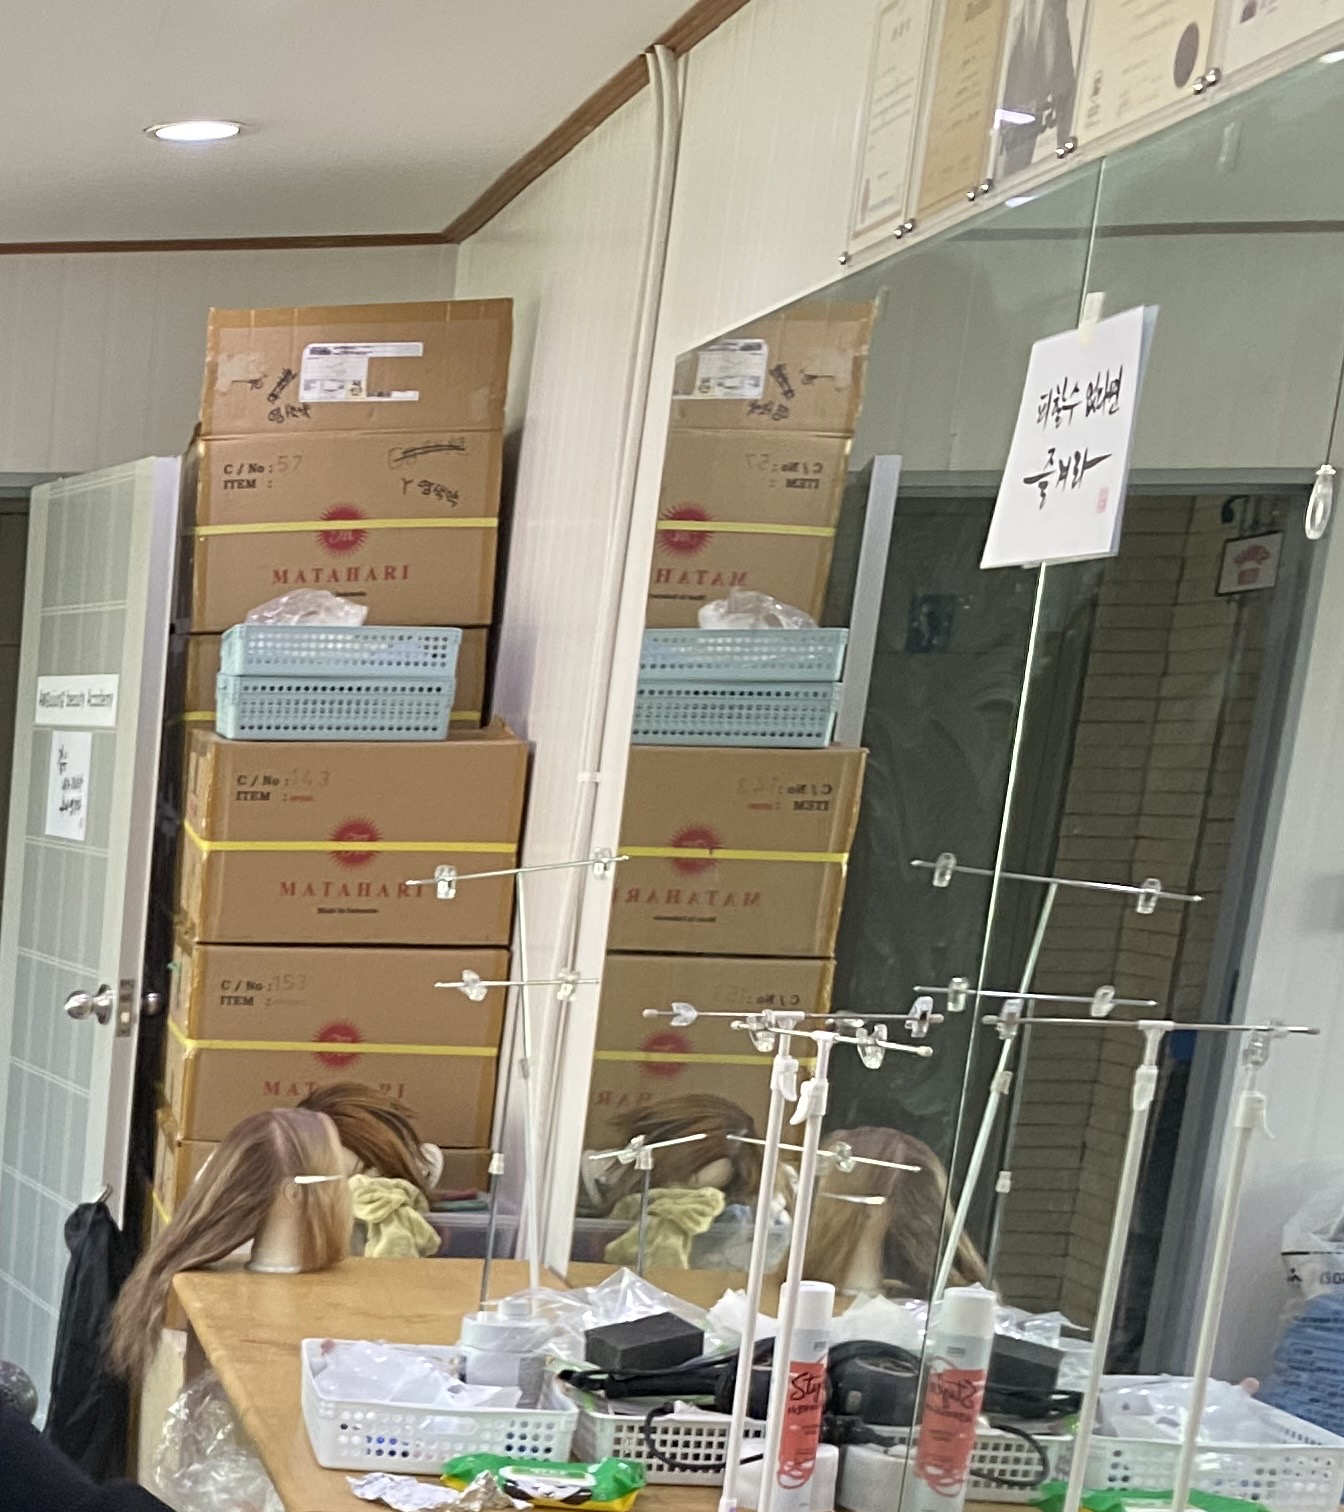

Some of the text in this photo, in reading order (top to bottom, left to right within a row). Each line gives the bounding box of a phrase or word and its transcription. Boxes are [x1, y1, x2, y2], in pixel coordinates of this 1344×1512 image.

[1023, 447, 1112, 510] 즐겨라
[271, 563, 410, 585] MATAHARI
[236, 791, 270, 802] ITEM
[279, 881, 424, 899] MATAHARI
[219, 995, 254, 1006] ITEM
